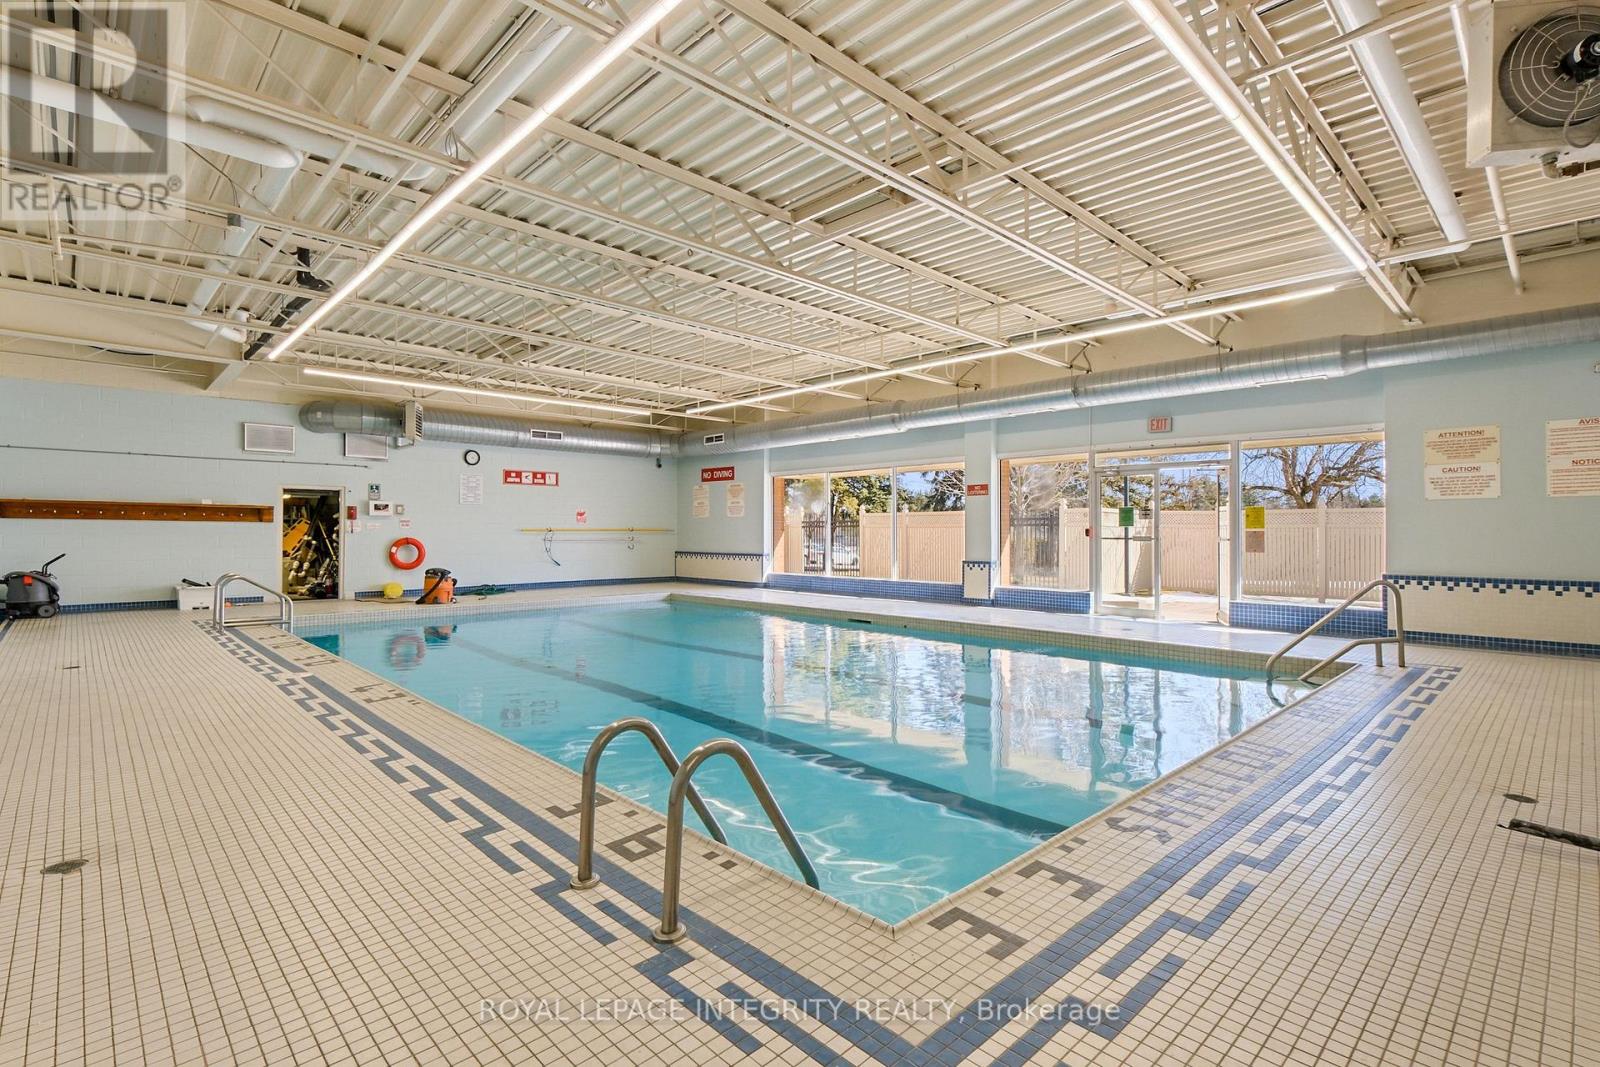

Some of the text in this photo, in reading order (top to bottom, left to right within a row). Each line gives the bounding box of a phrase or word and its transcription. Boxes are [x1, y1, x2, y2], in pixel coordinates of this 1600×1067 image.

[1150, 418, 1169, 432] EXIT
[1438, 430, 1485, 439] ATTENTION!
[702, 469, 733, 479] NO DIVING
[1441, 466, 1482, 474] CAUTION!
